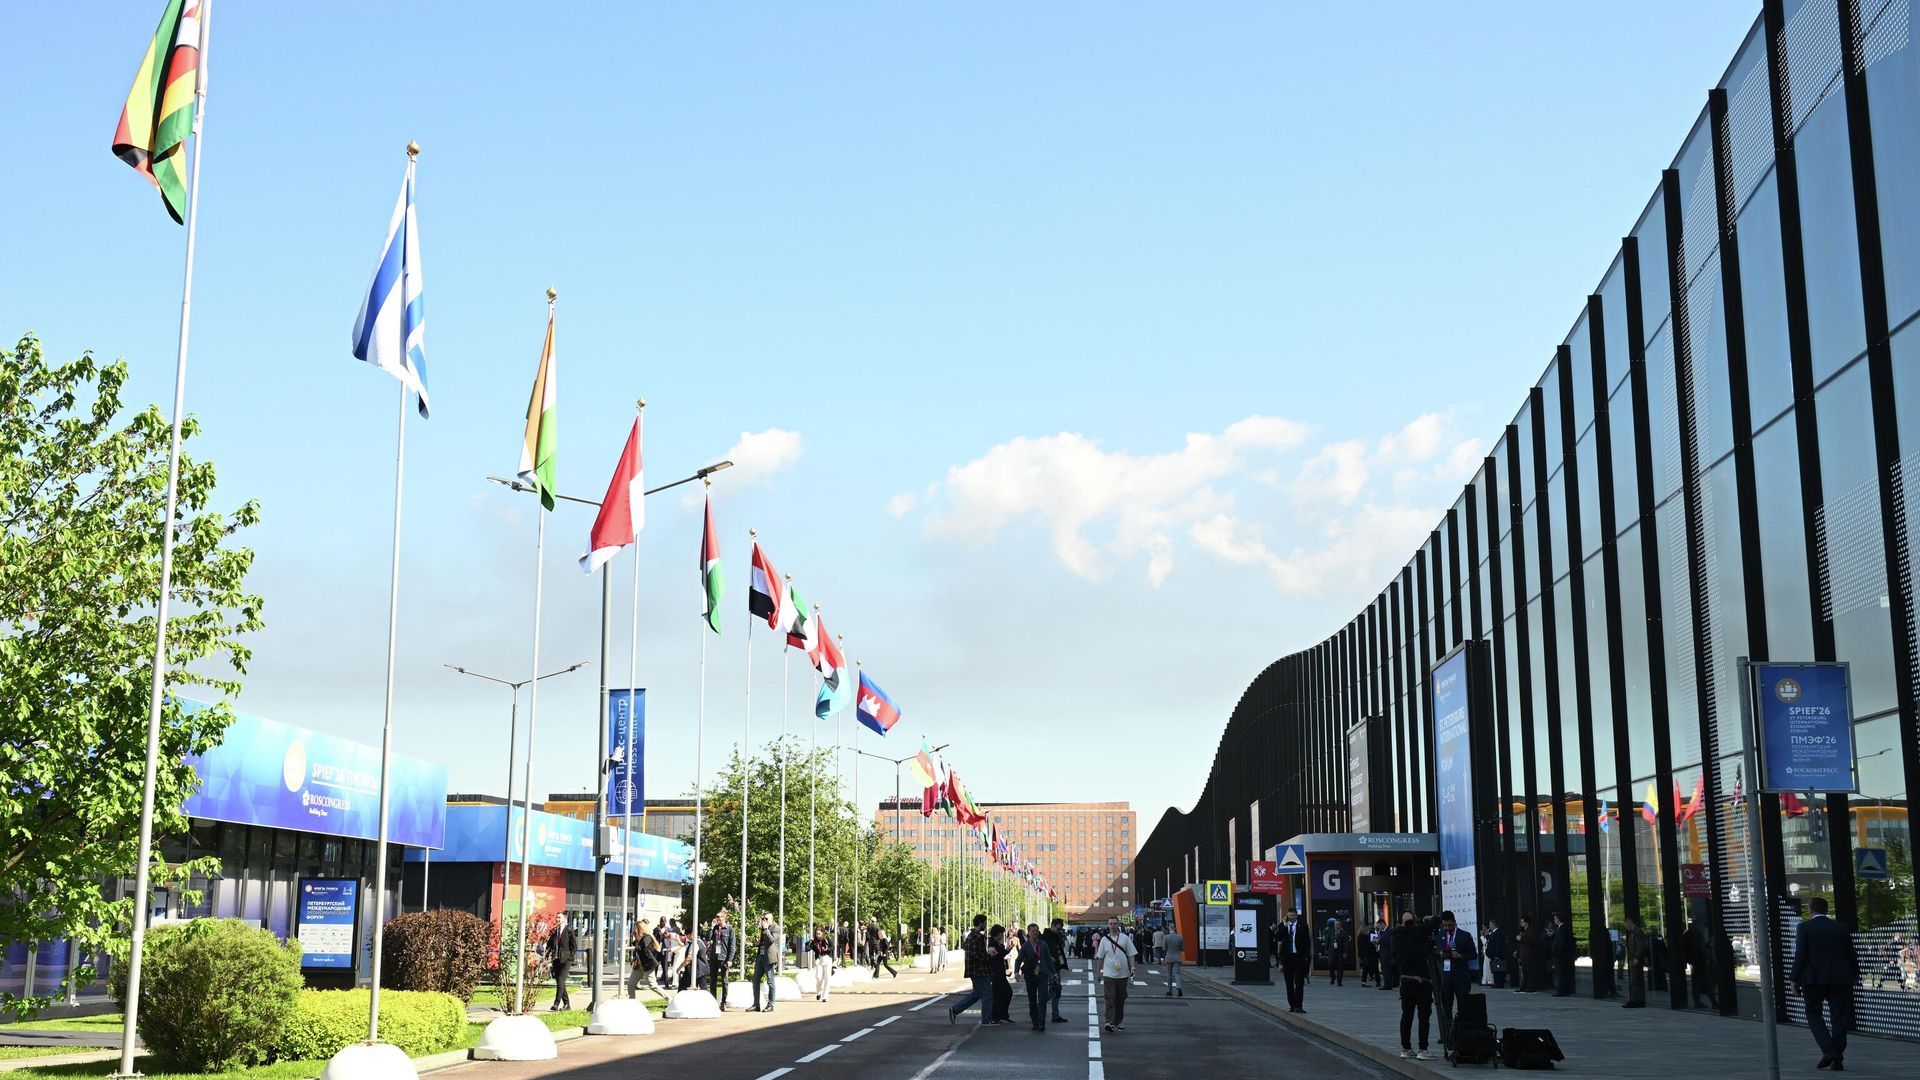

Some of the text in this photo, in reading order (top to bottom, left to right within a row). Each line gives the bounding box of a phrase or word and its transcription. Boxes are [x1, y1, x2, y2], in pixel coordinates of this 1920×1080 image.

[1789, 706, 1831, 715] SPIEF'26
[1791, 735, 1837, 744] ПМЭФ'26
[310, 794, 352, 810] ROSCONGRESS
[1323, 870, 1340, 890] G
